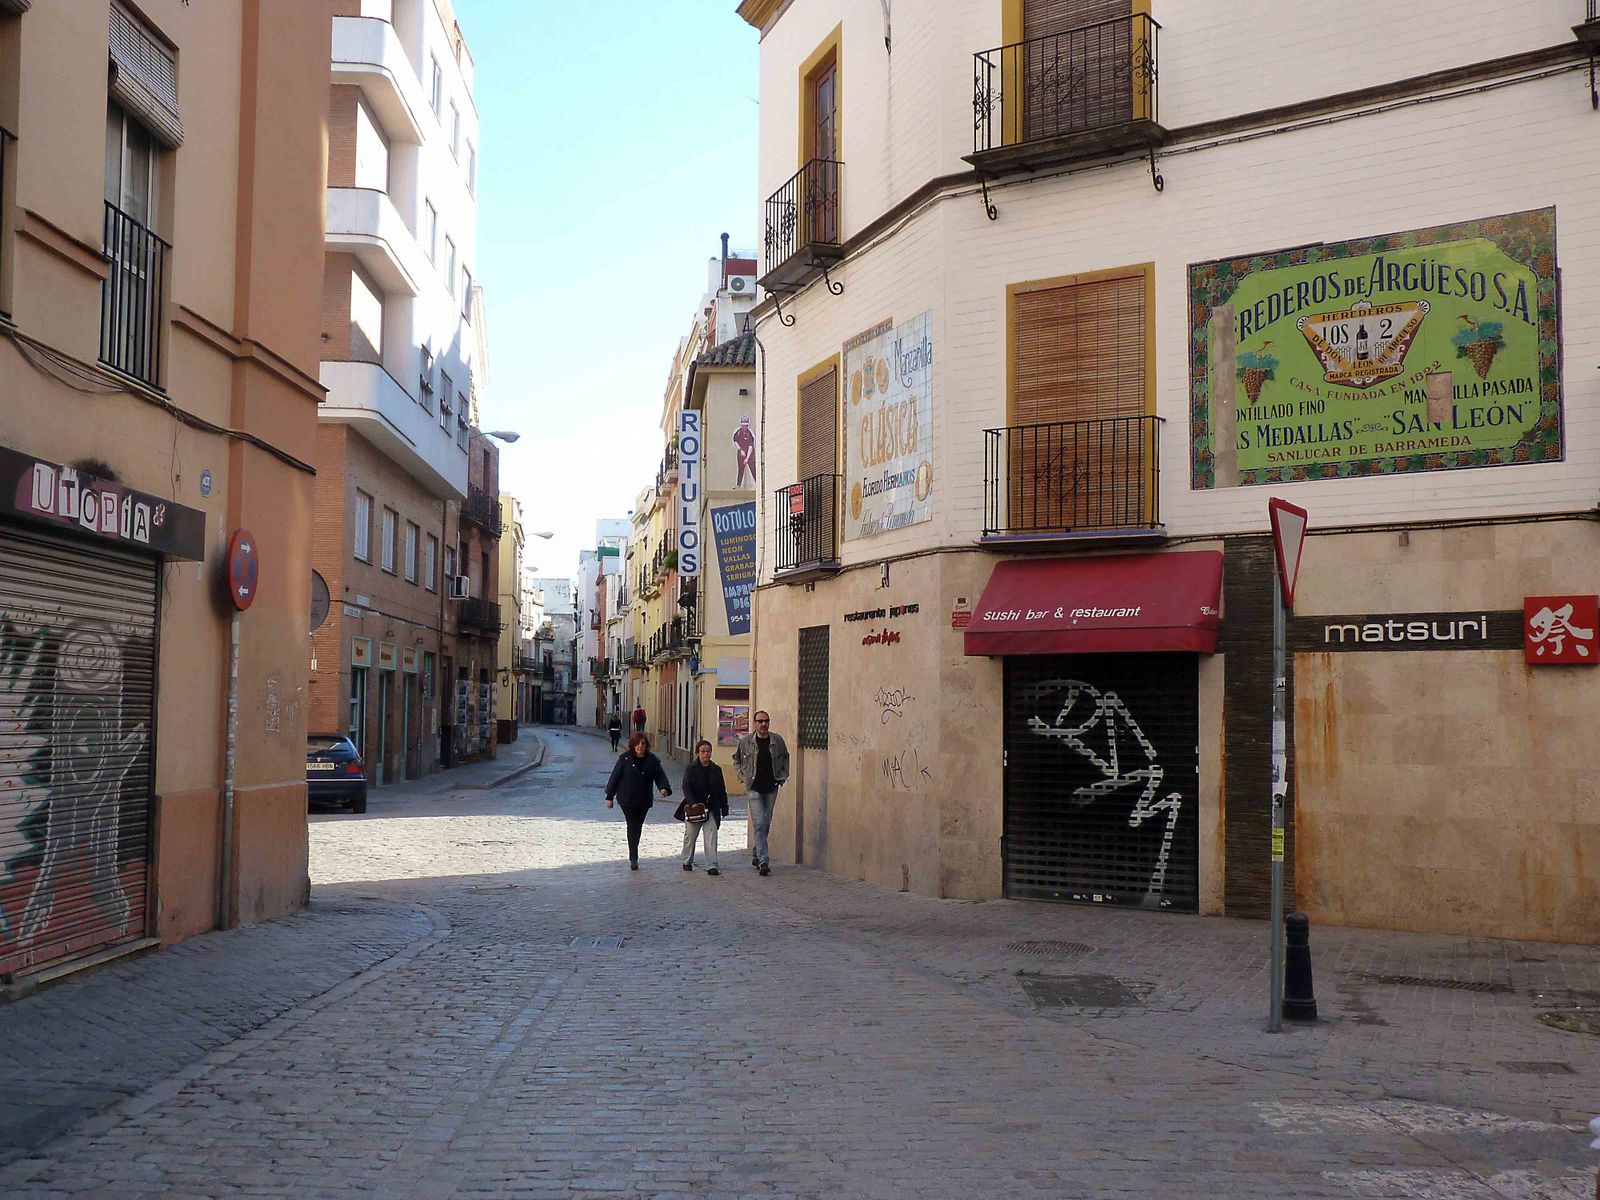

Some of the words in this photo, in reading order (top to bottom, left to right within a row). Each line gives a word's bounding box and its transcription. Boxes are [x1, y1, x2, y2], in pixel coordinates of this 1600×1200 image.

[1234, 271, 1341, 345] REDEROS
[1344, 276, 1367, 297] DE
[1365, 256, 1487, 302] ARGÜESO
[1492, 272, 1536, 327] S.A.
[1322, 305, 1403, 321] HEREDEROS
[1322, 323, 1350, 346] LOS
[1380, 318, 1393, 340] 2
[1329, 371, 1352, 380] MARCA
[1355, 366, 1399, 377] REGISTRADA
[1289, 376, 1320, 396] CASA
[1326, 388, 1387, 401] FUNDADA
[1390, 380, 1407, 394] EN
[1482, 377, 1534, 397] PASADA
[1299, 399, 1326, 416] FINO
[1267, 446, 1341, 462] SANLUCAR
[1348, 444, 1367, 456] DE
[1374, 434, 1472, 453] BARRAMEDA
[680, 412, 698, 574] ROTULOS
[714, 509, 757, 533] ROTULO
[725, 562, 756, 572] GRABAD
[983, 609, 1022, 621] sushi
[1025, 608, 1050, 620] bar
[1053, 606, 1064, 619] &
[1069, 606, 1142, 618] restaurant
[1325, 615, 1487, 643] matsuri
